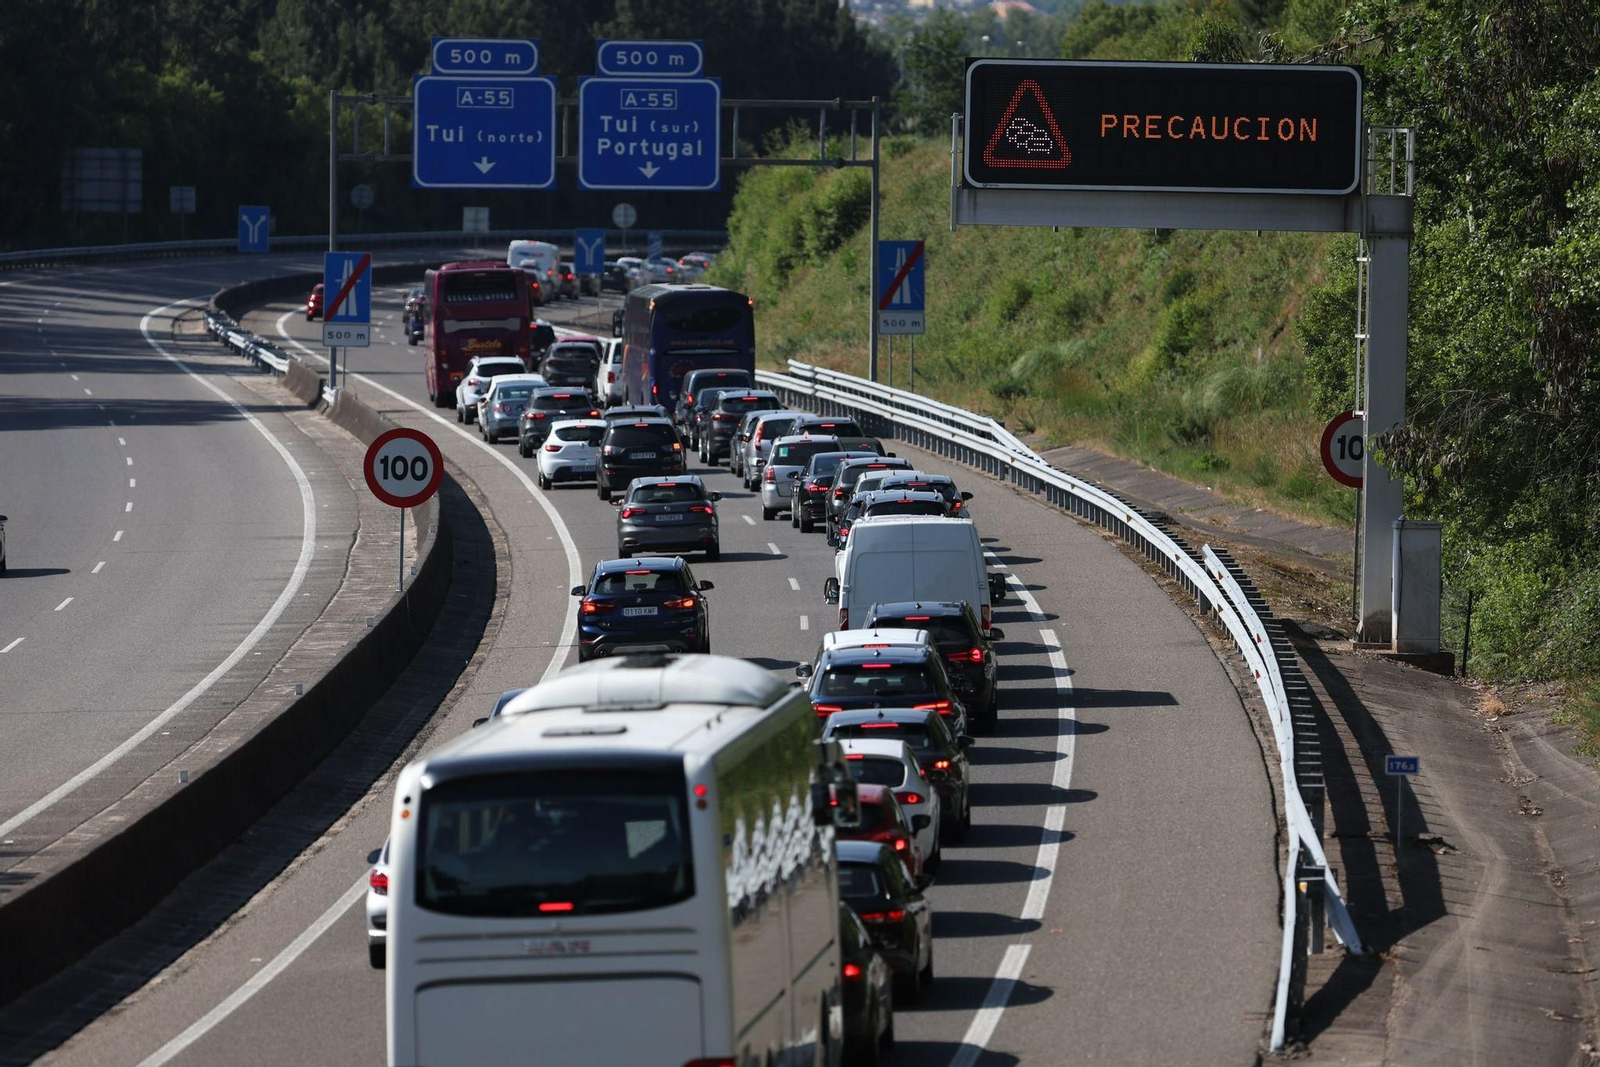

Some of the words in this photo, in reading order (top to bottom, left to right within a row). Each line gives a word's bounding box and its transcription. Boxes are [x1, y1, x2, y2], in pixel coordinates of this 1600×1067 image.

[450, 49, 492, 64] 500
[505, 52, 521, 64] m
[616, 51, 658, 65] 500
[669, 54, 685, 66] m
[460, 90, 510, 105] A-55
[625, 92, 674, 107] A-55
[600, 115, 637, 132] Tui
[650, 120, 699, 133] (sur)
[1100, 114, 1318, 142] PRECAUCION
[426, 125, 464, 142] Tui
[477, 130, 543, 144] (norte)
[598, 138, 703, 161] Portugal
[883, 319, 906, 327] 500
[327, 331, 351, 340] 500
[779, 448, 788, 457] L
[1337, 435, 1364, 461] 10
[379, 455, 428, 482] 100
